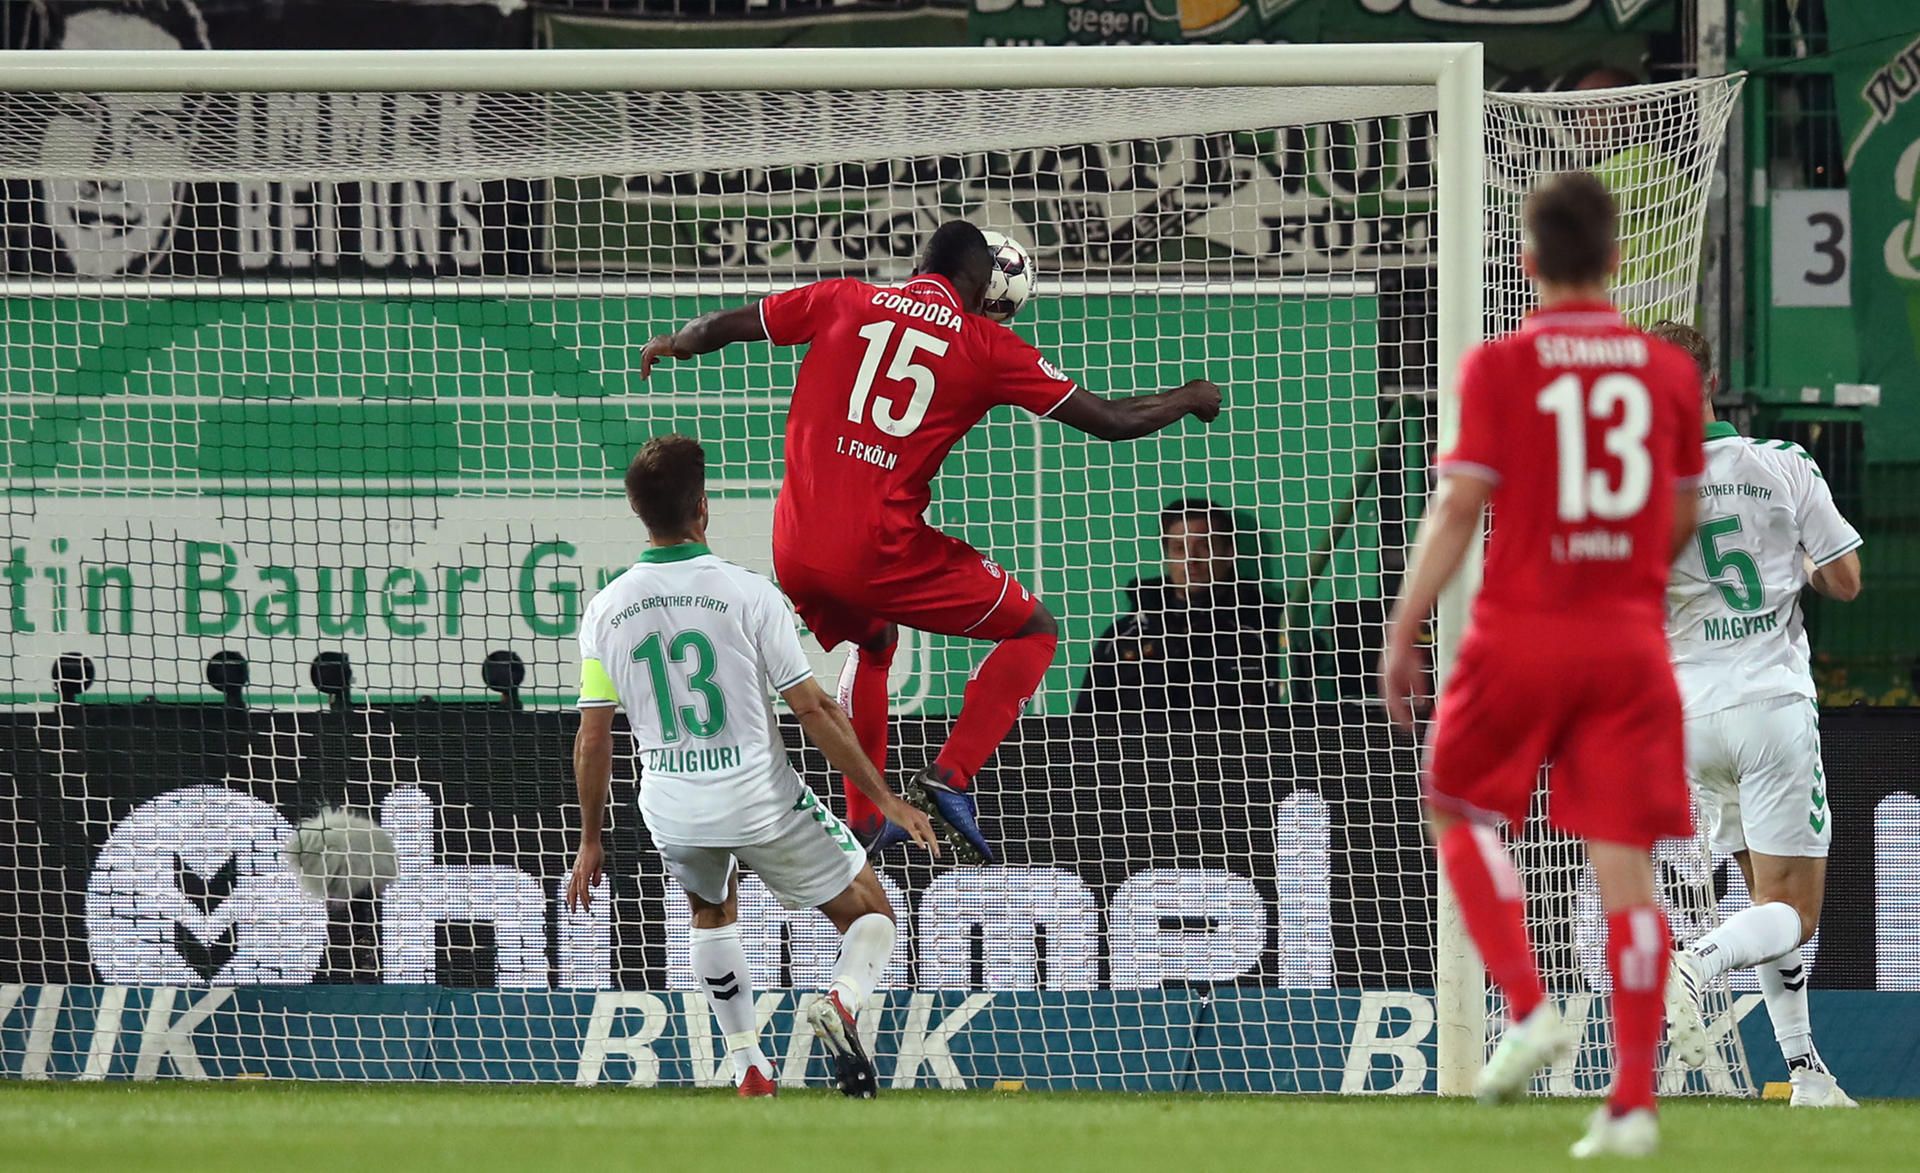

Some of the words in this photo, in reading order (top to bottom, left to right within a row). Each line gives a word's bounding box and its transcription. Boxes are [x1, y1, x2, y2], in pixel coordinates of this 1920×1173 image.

[1068, 7, 1148, 32] gegen
[360, 179, 482, 268] UNS
[1803, 212, 1846, 285] 3
[872, 291, 964, 333] CORDOBA
[847, 319, 950, 438] 15
[1536, 372, 1652, 522] 13
[1737, 482, 1772, 501] FÜRTH
[185, 541, 481, 636] Bauer
[1696, 514, 1766, 614] 5
[611, 603, 640, 628] SPVGG
[642, 596, 692, 609] GREUTHER
[695, 595, 728, 613] FÜRTH
[1704, 610, 1778, 641] MAGYAR
[630, 628, 726, 743] 13
[649, 745, 742, 773] CALIGIURI
